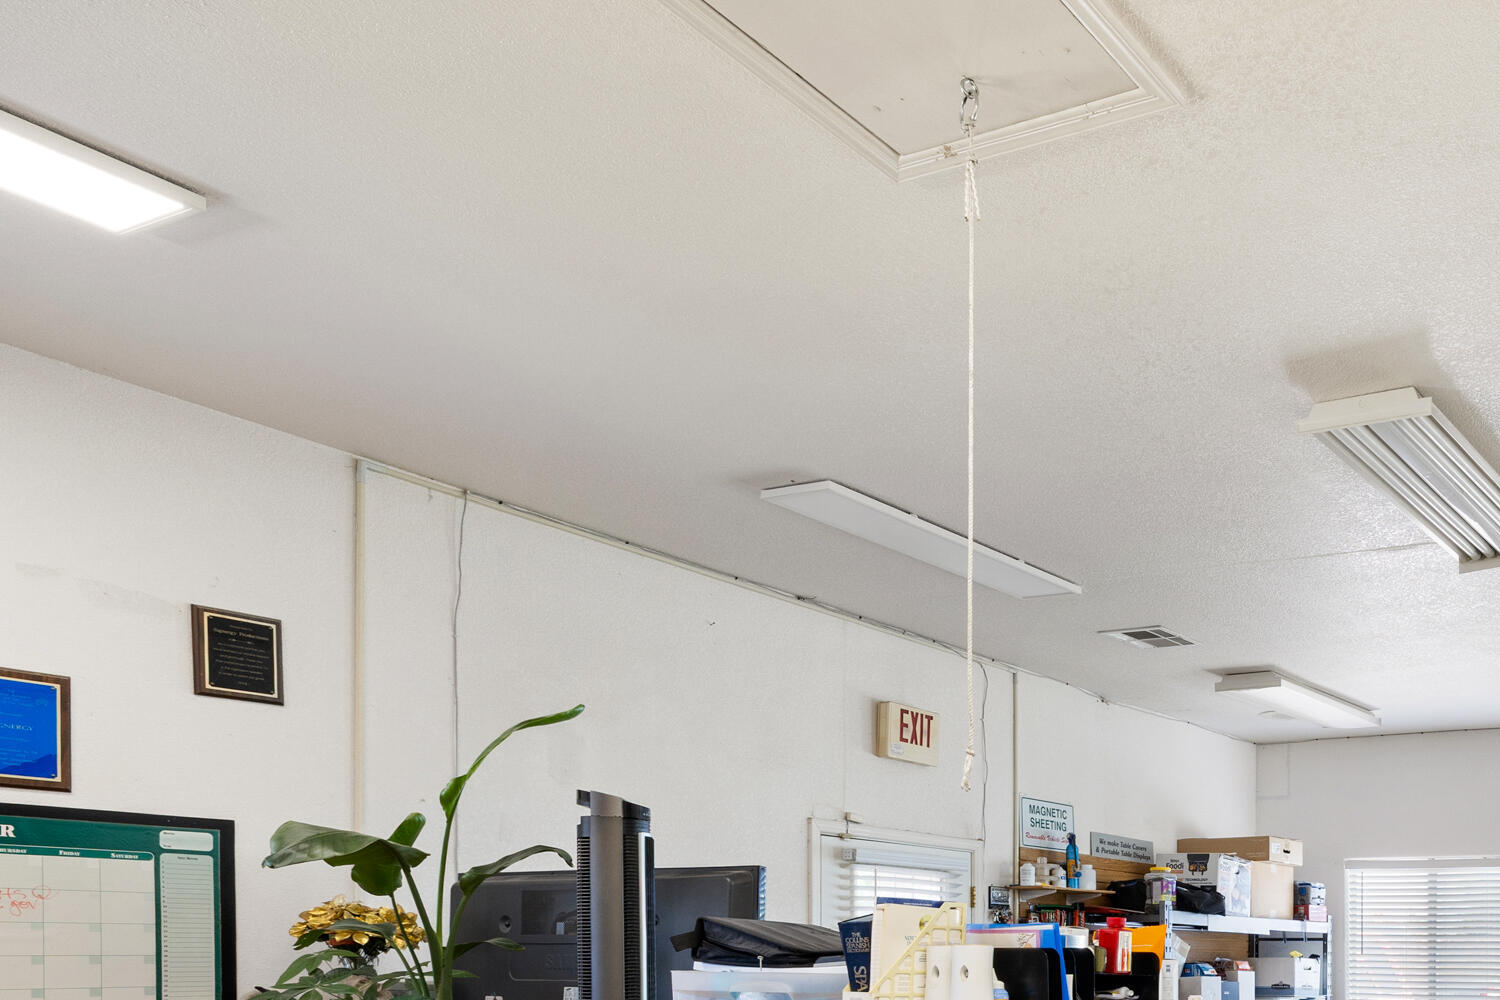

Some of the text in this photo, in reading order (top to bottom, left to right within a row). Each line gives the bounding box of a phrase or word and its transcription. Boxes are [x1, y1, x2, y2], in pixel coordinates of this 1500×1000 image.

[899, 708, 934, 749] EXIT
[1028, 803, 1068, 820] MAGNETIC
[1029, 817, 1067, 832] SHEETING
[1098, 837, 1147, 852] We make Table Covers
[1101, 848, 1120, 857] Portable
[1120, 850, 1132, 858] Table
[1132, 852, 1151, 861] Displays
[1165, 862, 1185, 870] Foodi
